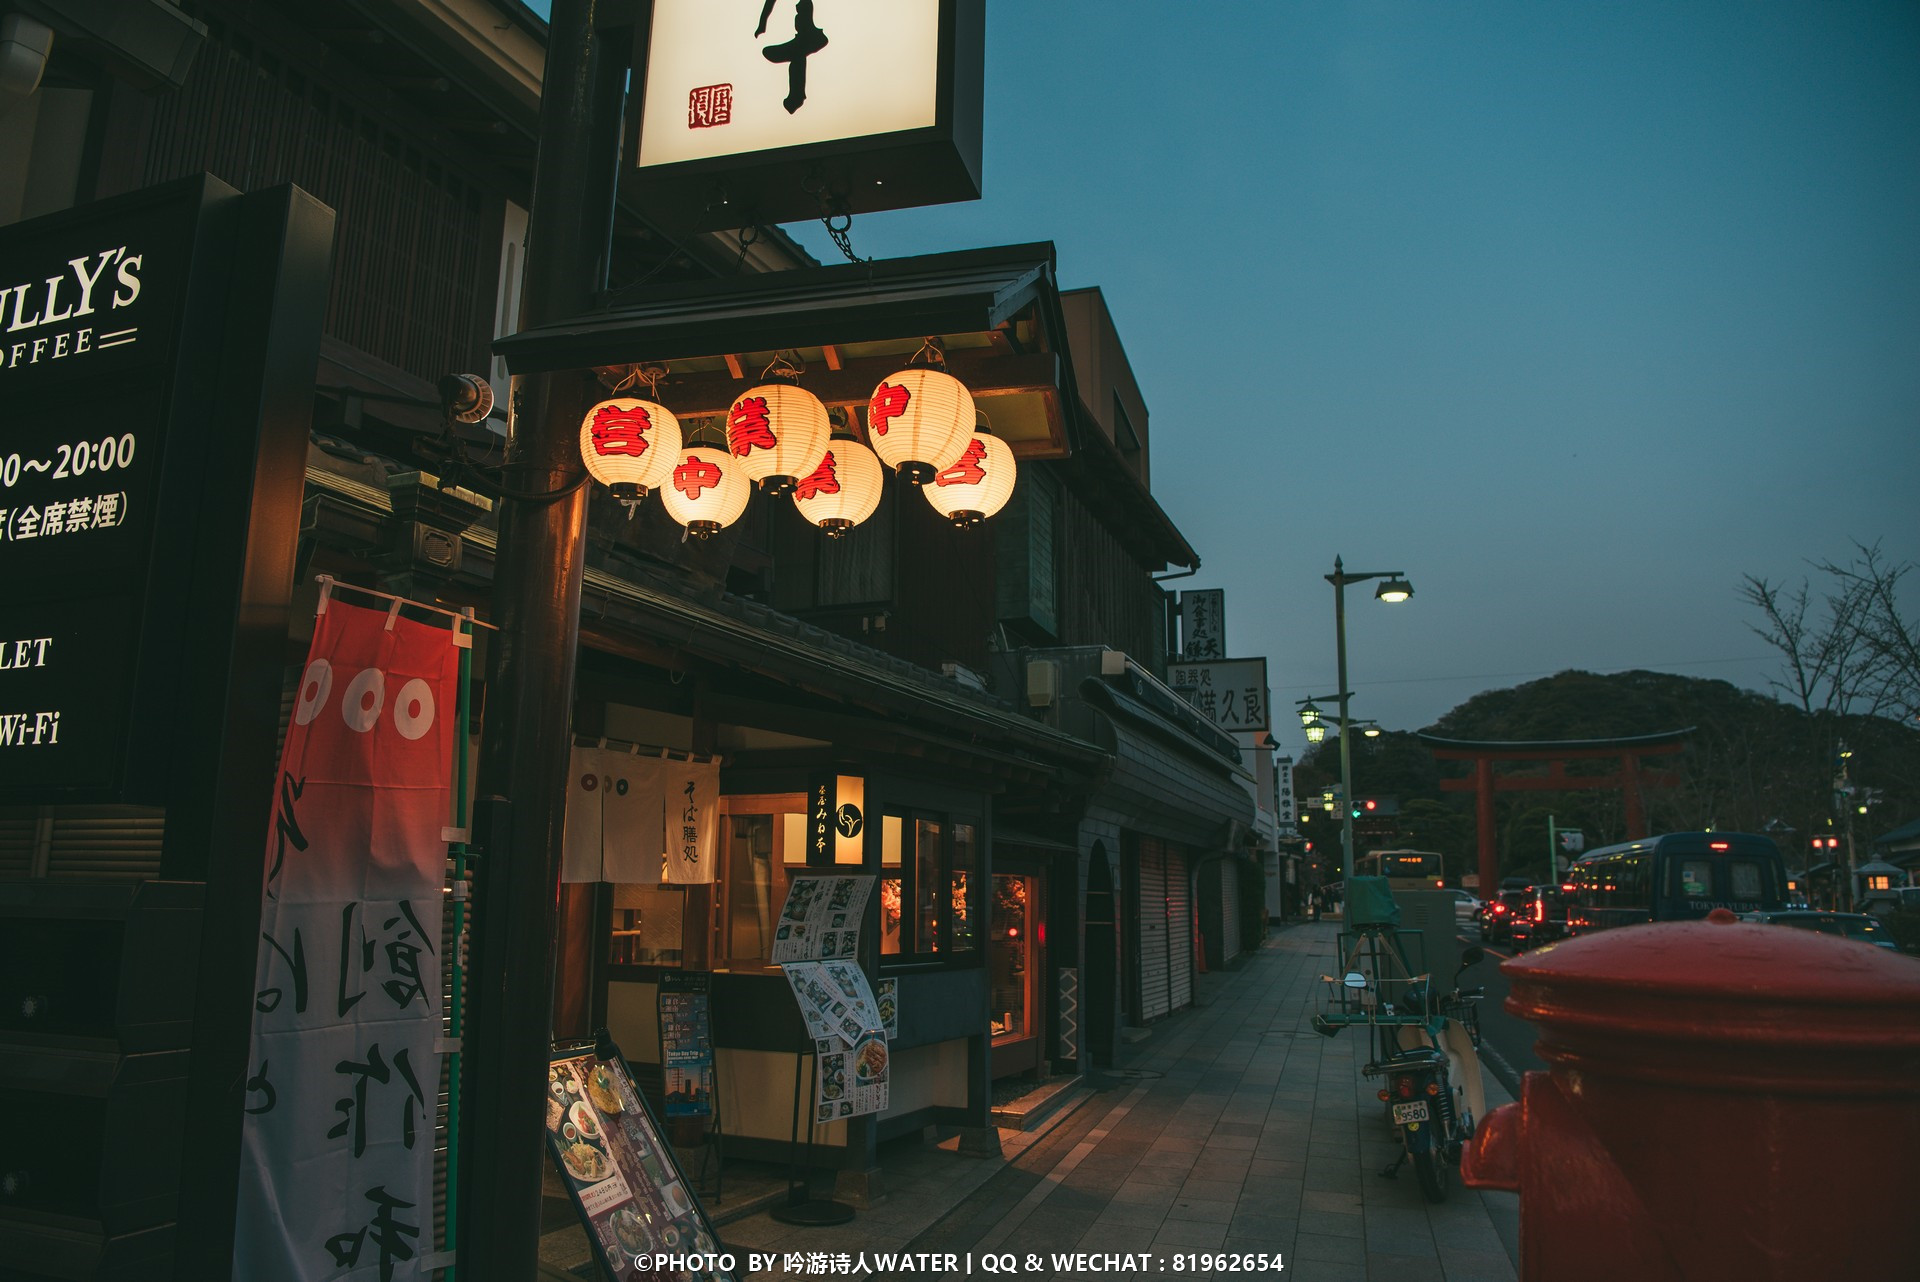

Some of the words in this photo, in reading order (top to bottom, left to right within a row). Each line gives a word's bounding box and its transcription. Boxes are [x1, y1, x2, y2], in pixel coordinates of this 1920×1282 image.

[591, 405, 652, 457] 営
[727, 396, 777, 458] 業
[868, 382, 911, 436] 中
[673, 456, 722, 500] 中
[0, 711, 60, 746] Wi-Fi
[682, 781, 699, 863] そば膳処
[1402, 1108, 1426, 1121] 9580
